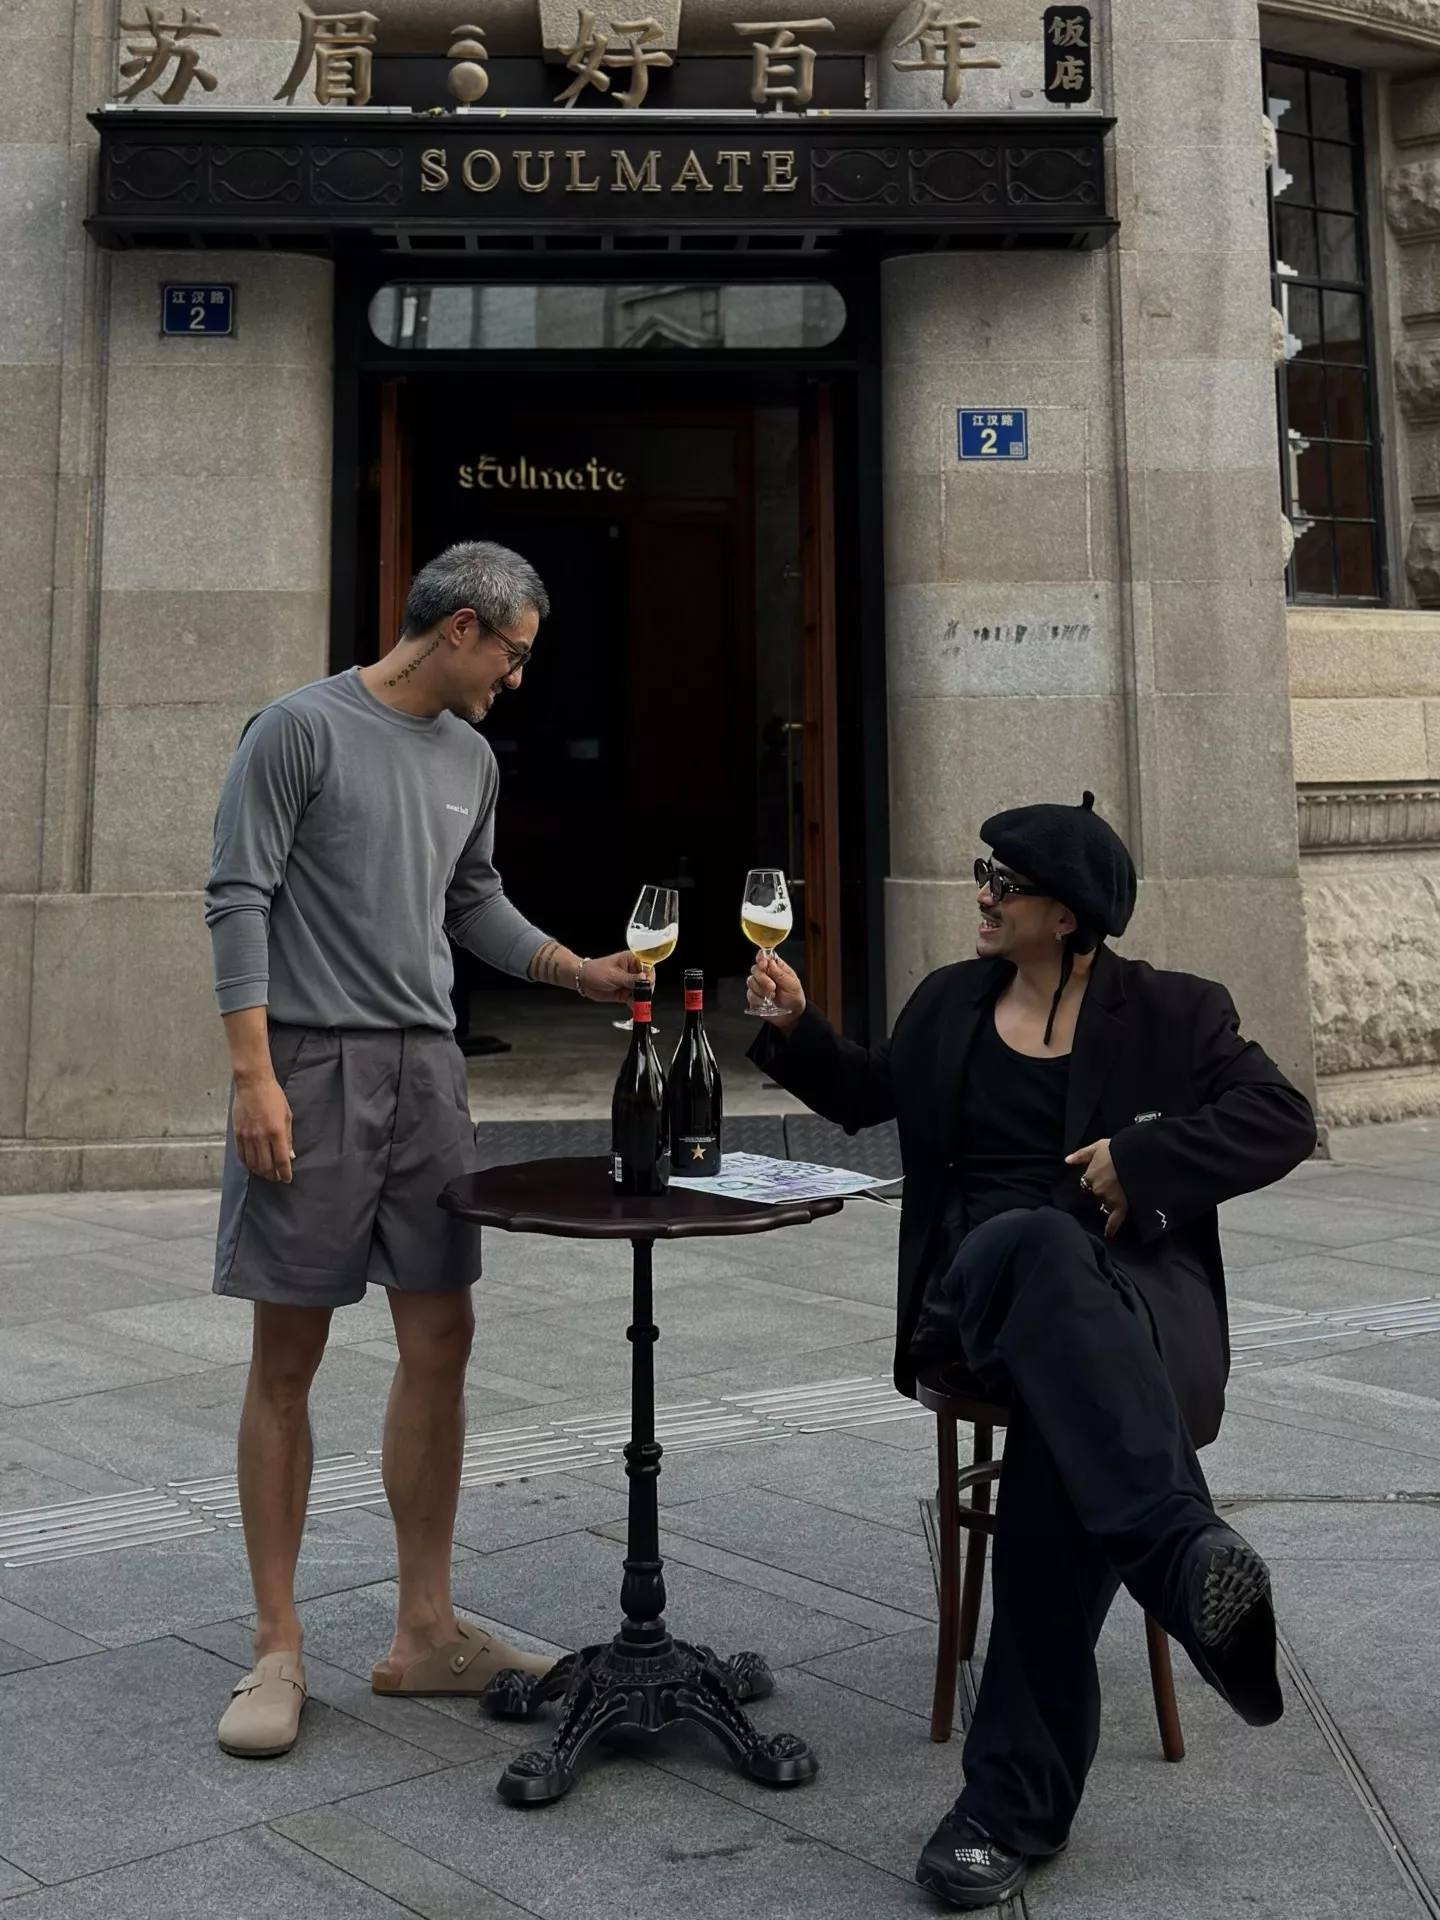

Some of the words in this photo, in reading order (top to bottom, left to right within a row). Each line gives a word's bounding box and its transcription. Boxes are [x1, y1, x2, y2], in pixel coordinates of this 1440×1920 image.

[553, 1, 1002, 109] 好百年
[1049, 15, 1089, 93] 饭店
[420, 148, 799, 193] SOULMATE
[172, 291, 225, 304] 江汉路
[189, 306, 206, 330] 2
[972, 414, 1014, 427] 江汉路
[980, 428, 998, 454] 2
